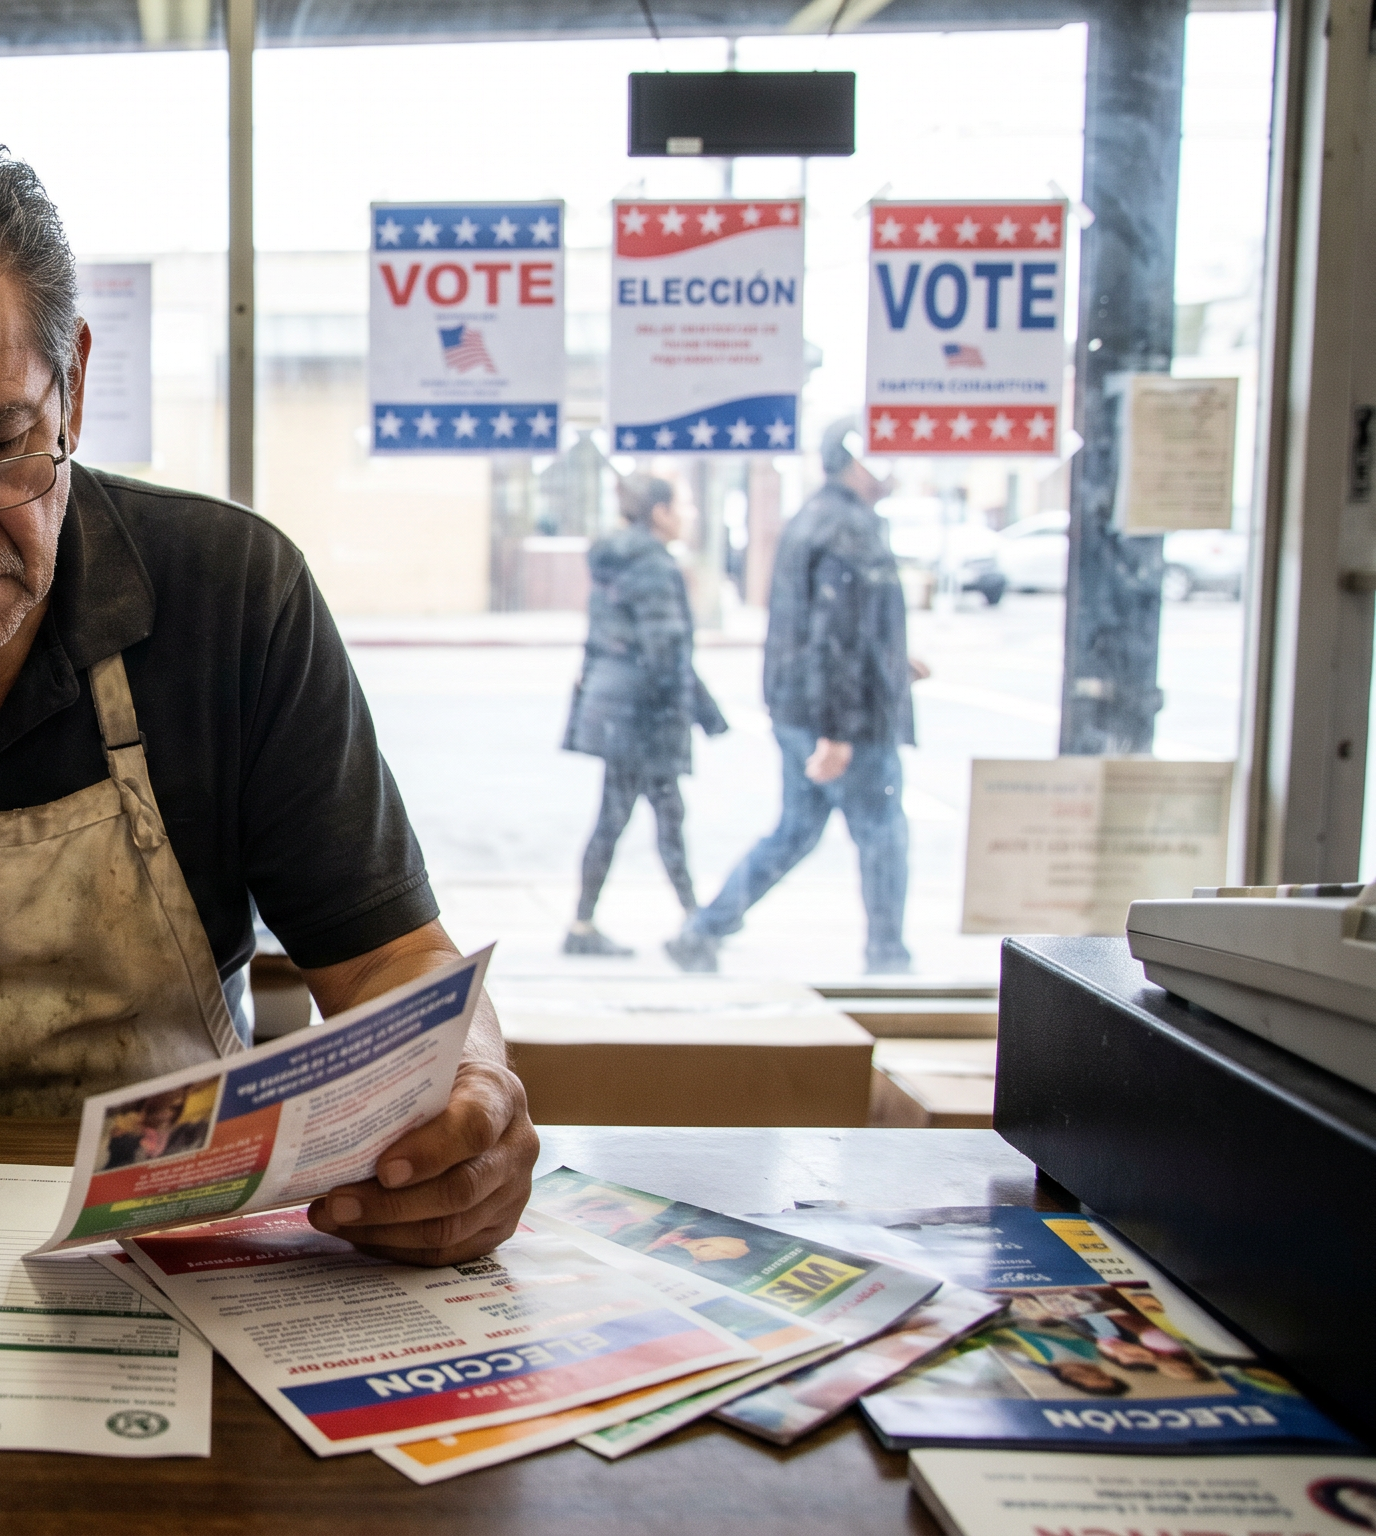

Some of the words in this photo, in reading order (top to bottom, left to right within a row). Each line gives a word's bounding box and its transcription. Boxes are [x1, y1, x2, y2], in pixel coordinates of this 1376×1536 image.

[379, 261, 555, 307] VOTE
[617, 269, 797, 306] ELECCIÓN
[875, 261, 1058, 331] VOTE
[365, 1331, 611, 1398] ELECCIÓN
[1042, 1404, 1279, 1434] ELECCIÓN
